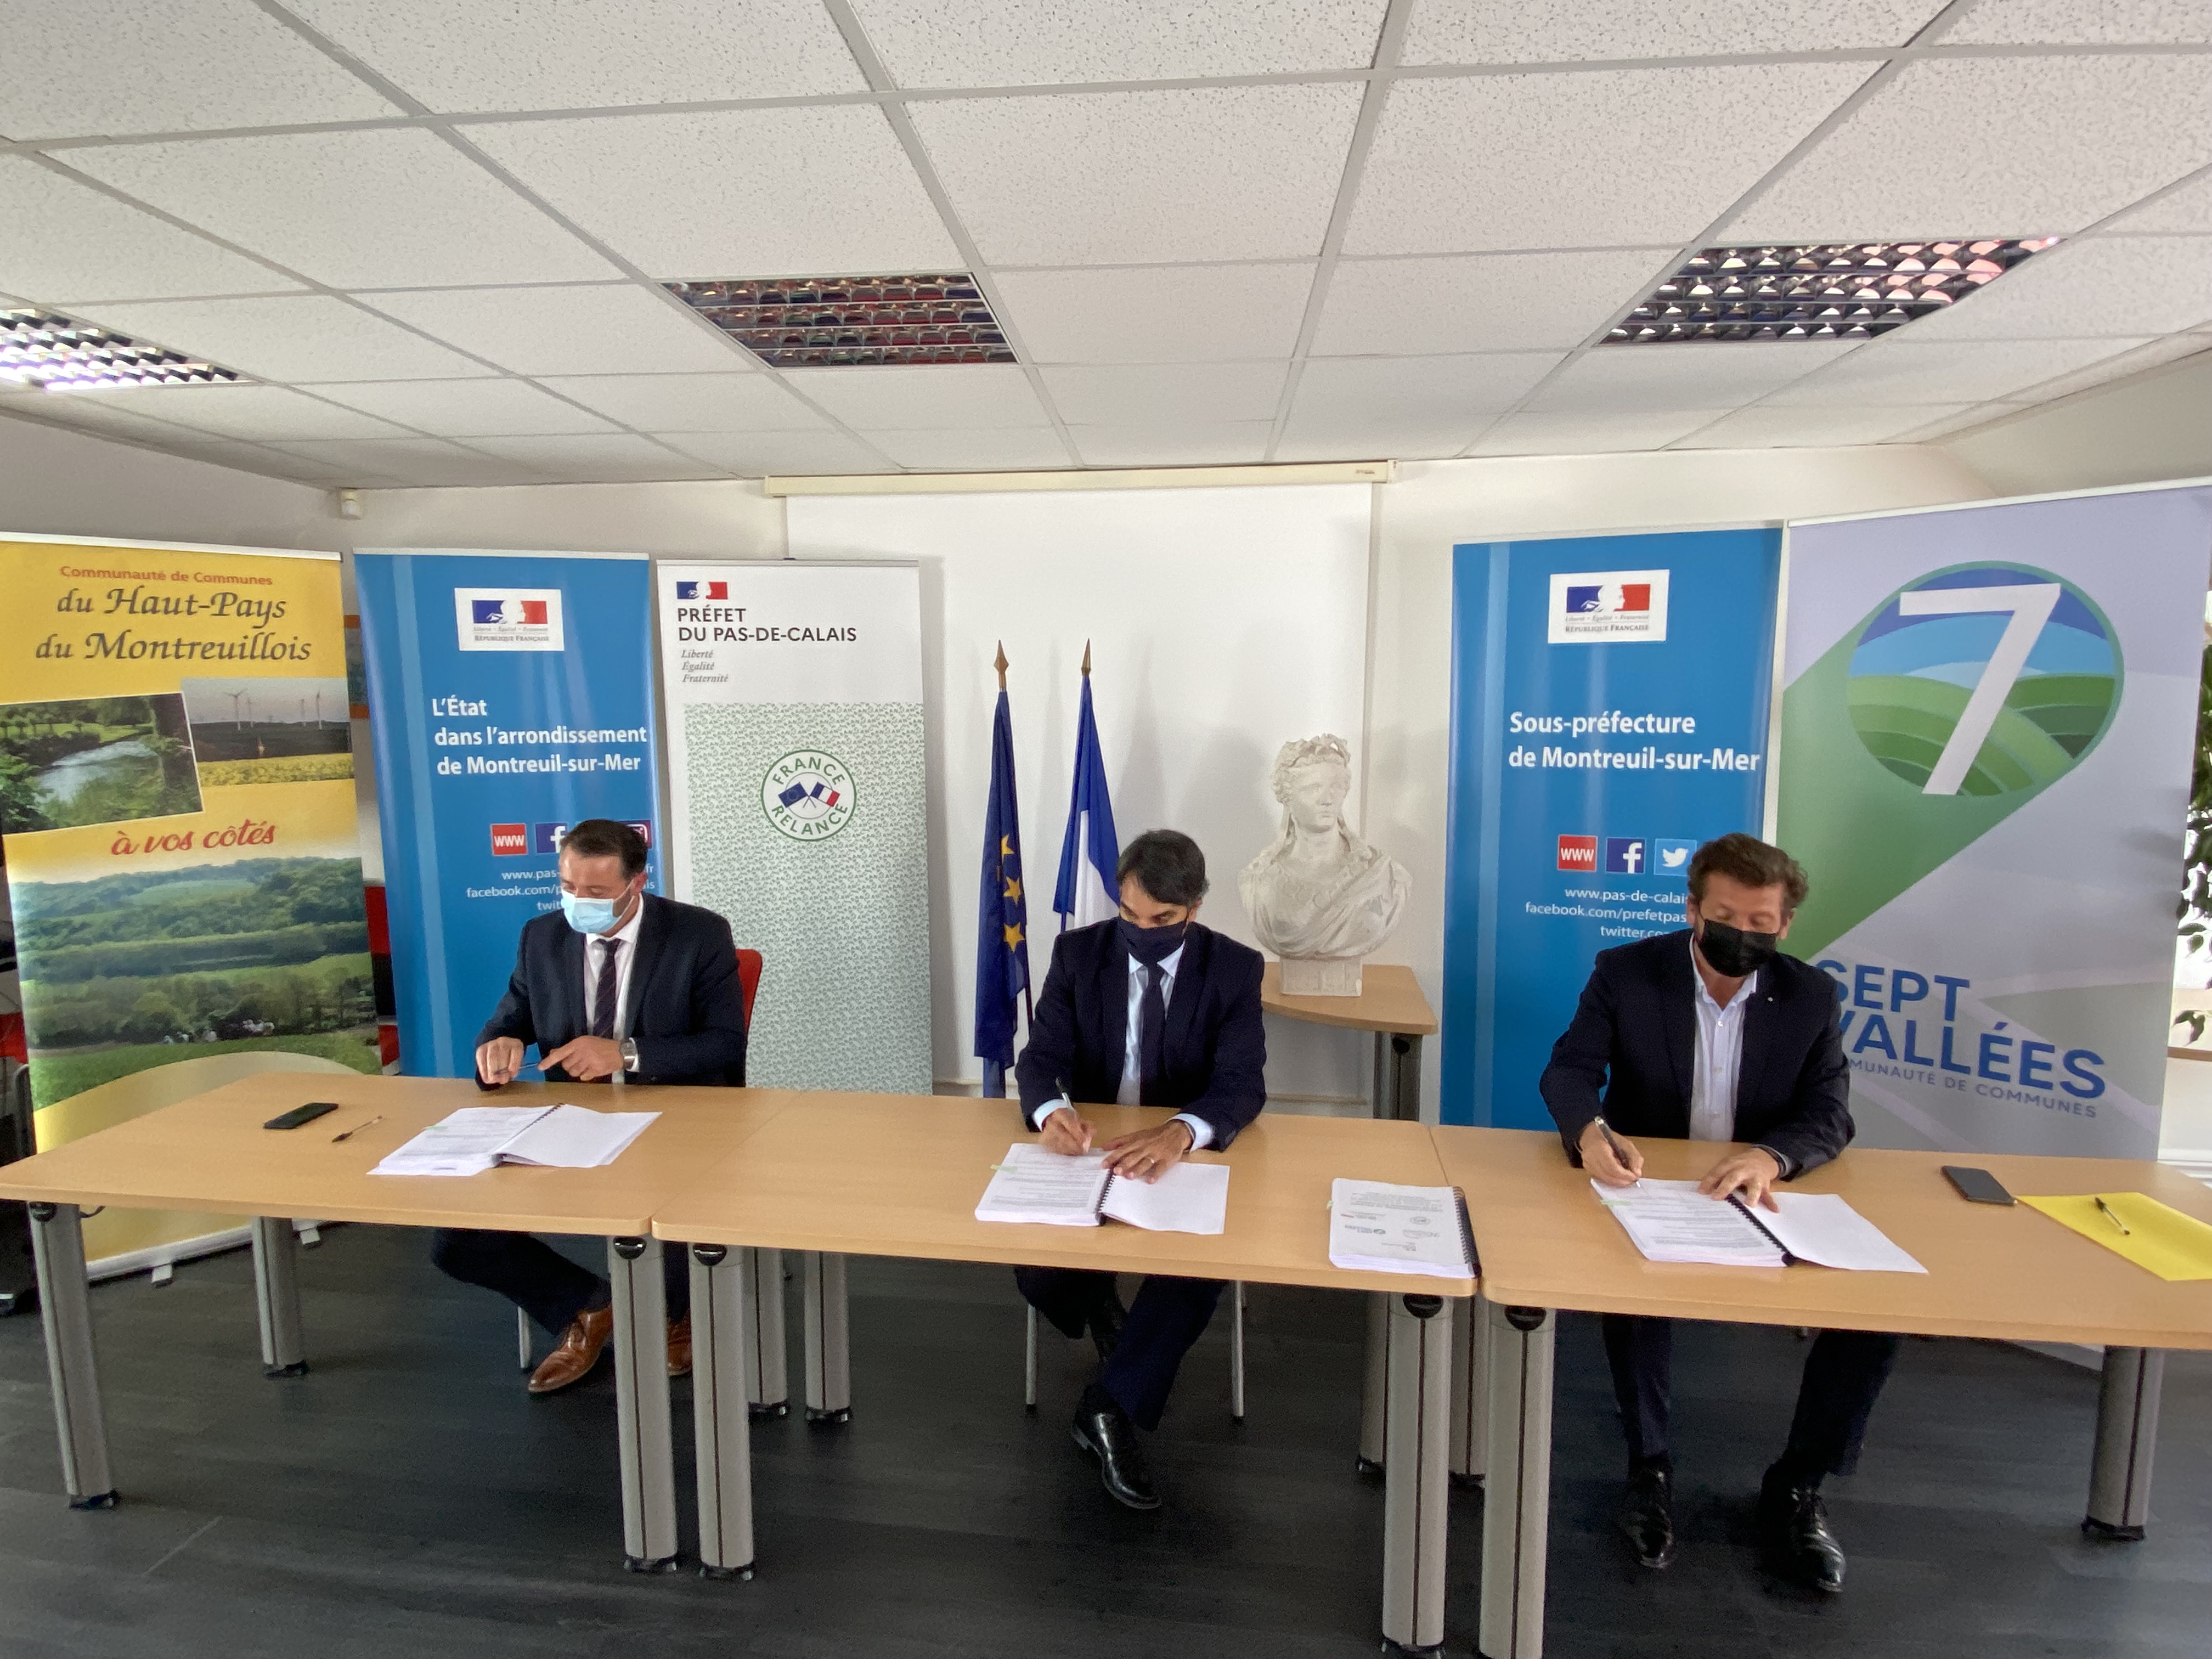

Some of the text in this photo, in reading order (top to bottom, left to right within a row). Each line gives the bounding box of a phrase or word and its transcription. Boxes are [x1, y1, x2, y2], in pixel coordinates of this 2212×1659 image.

[60, 566, 273, 585] Communauté de Communes
[58, 585, 287, 629] du Haut-Pays
[678, 605, 747, 622] PRÉFET
[36, 629, 312, 660] du Montreuillois
[679, 627, 857, 641] DU PAS-DE-CALAIS
[681, 649, 714, 658] Liberté
[681, 660, 715, 673] Égalité
[682, 674, 729, 683] Fraternité
[1899, 583, 2061, 795] 7
[432, 695, 488, 716] L'État
[1510, 710, 1695, 738] Sous-préfecture
[435, 725, 647, 746] dans l'arrondissement
[437, 753, 641, 775] de Montreuil-sur-Mer
[1509, 745, 1760, 771] de Montreuil-sur-Mer
[772, 757, 845, 785] FRANCE
[771, 803, 848, 835] RELANCE
[111, 819, 276, 855] à vos côtés
[467, 884, 561, 898] facebook.com/p
[1526, 902, 1686, 924] facebook.com/prefetpas
[1600, 926, 1669, 938] twitter.co
[1849, 1059, 2097, 1118] MUNAUTÉ DE COMMUNES
